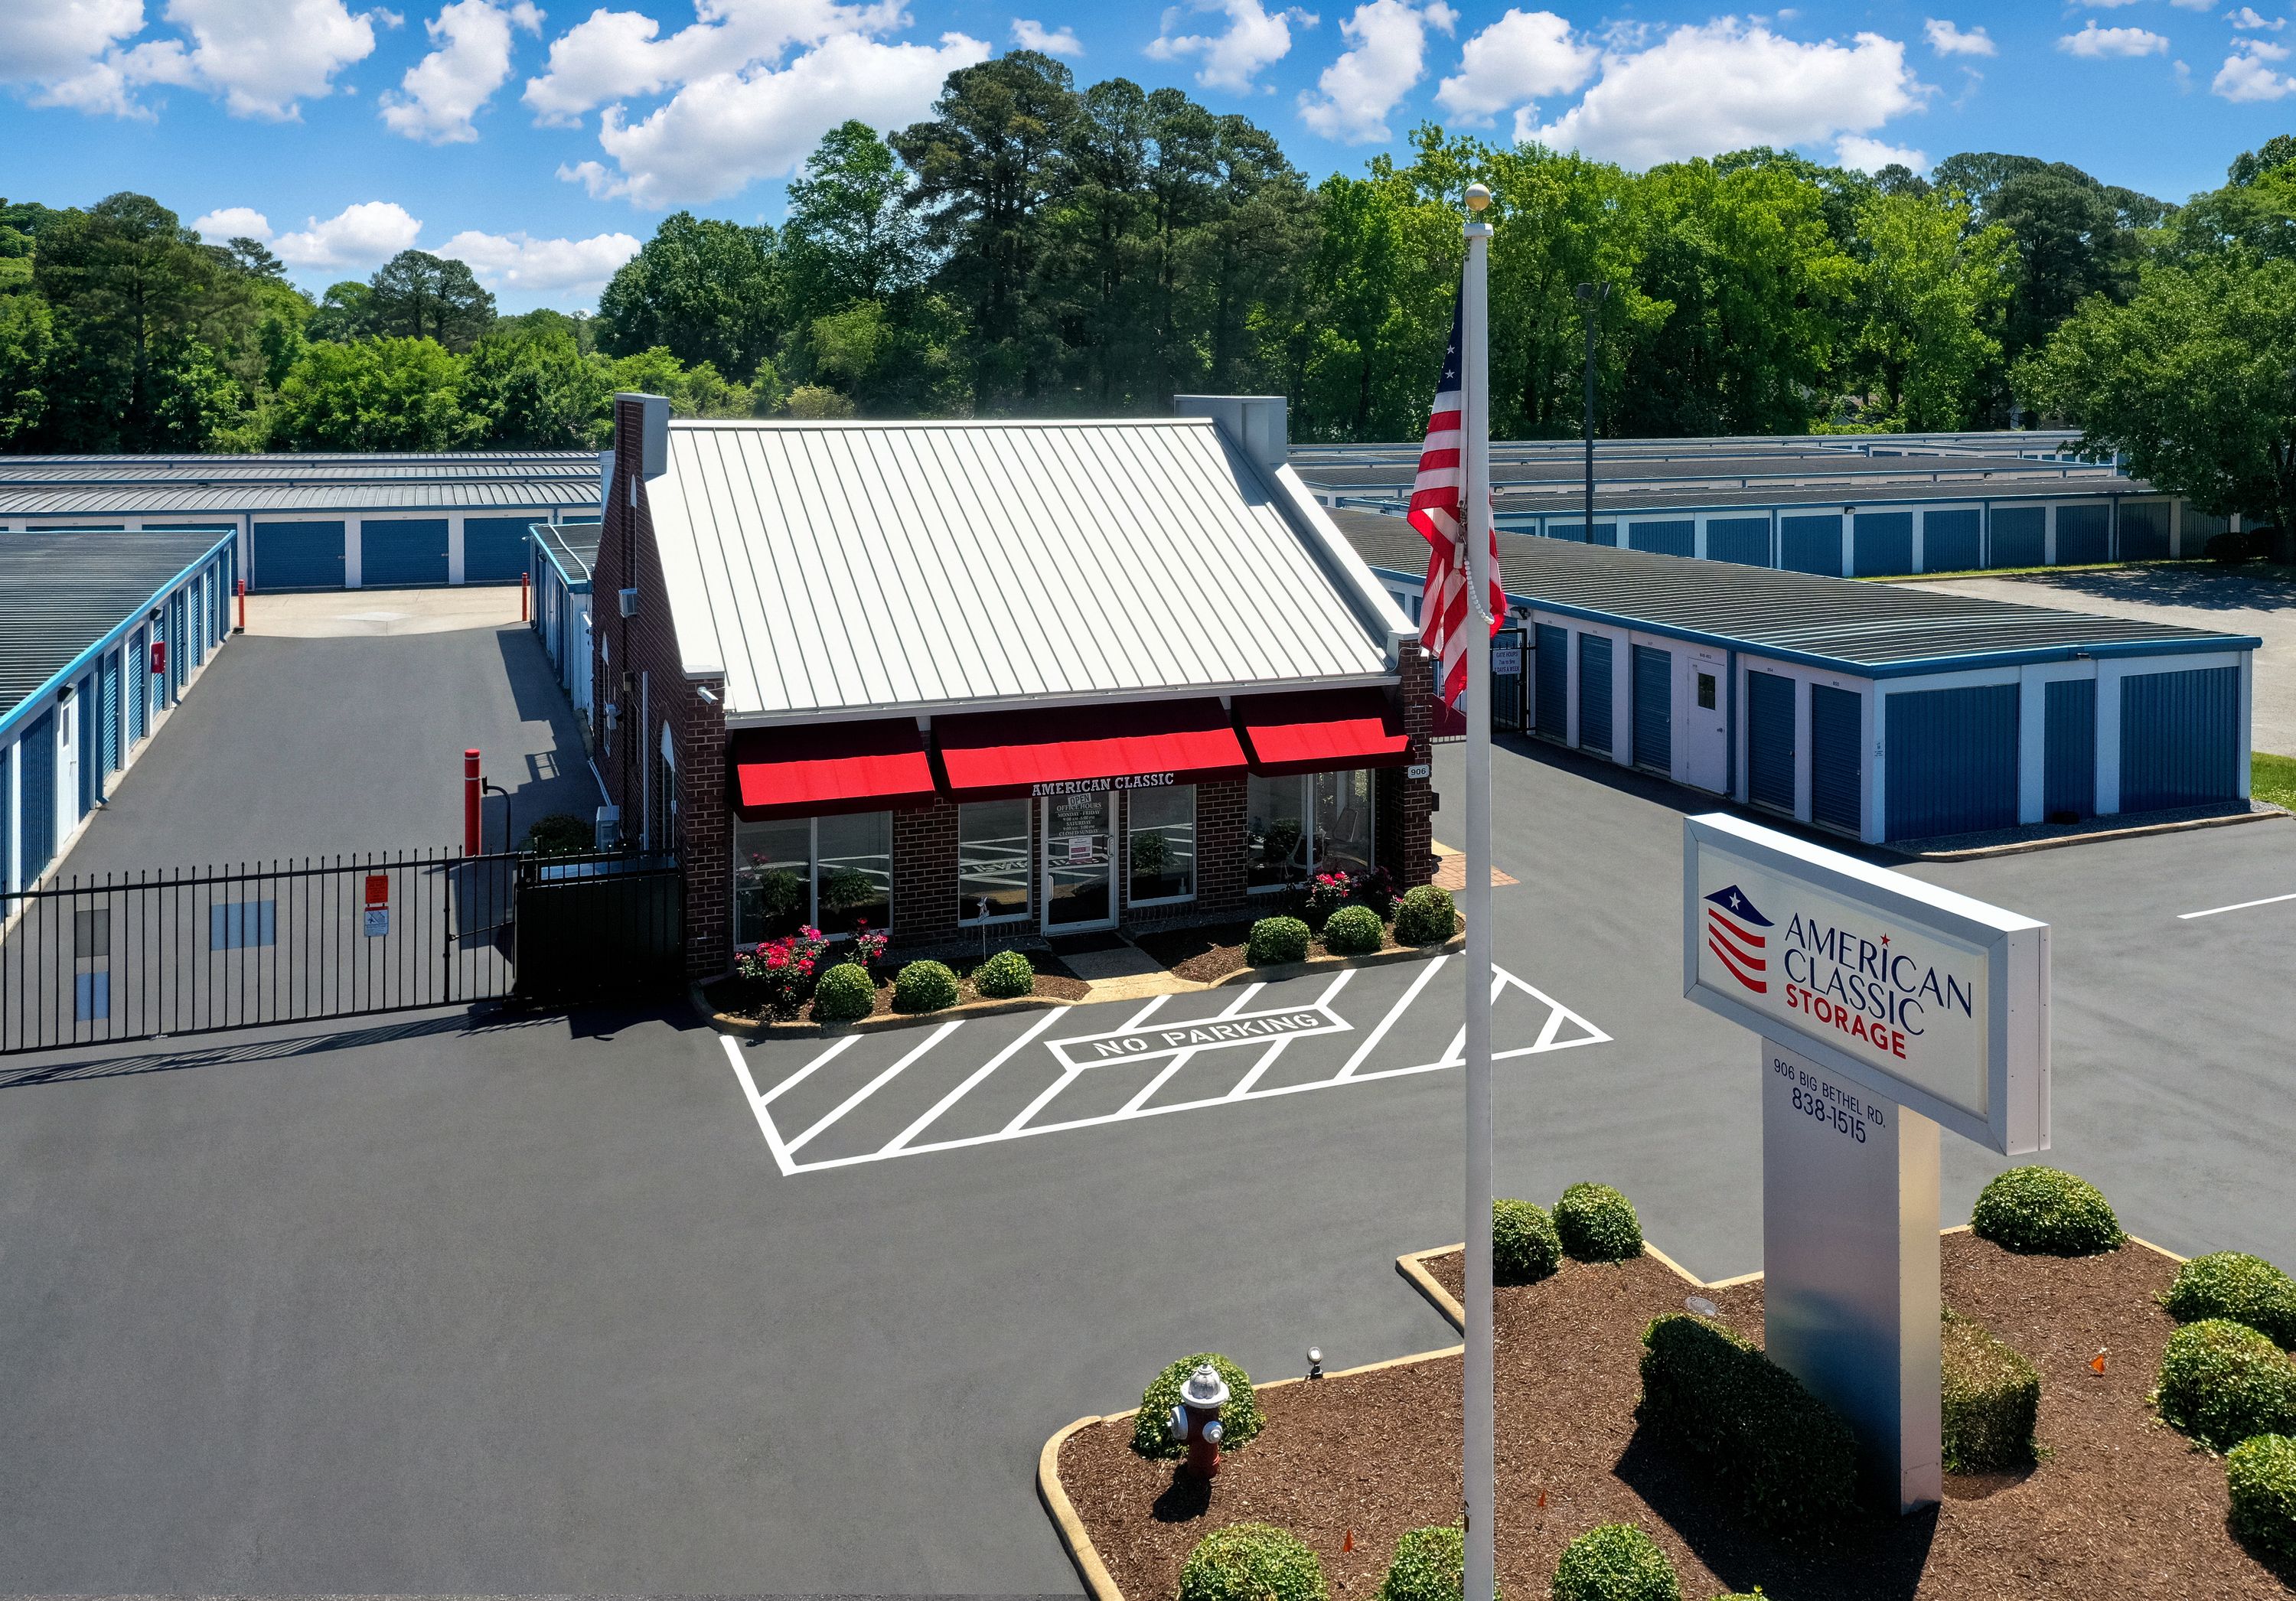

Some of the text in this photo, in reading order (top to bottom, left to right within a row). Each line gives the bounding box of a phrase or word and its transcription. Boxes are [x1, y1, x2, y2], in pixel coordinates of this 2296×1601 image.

[1032, 773, 1174, 796] AMERICAN CLASSIC
[1071, 793, 1090, 804] OPEN
[1411, 768, 1427, 776] 906
[1784, 948, 1925, 1035] CLASSIC
[1785, 912, 1972, 1019] AMERICAN
[1093, 1013, 1319, 1058] NO PARKING
[1786, 983, 1906, 1060] STORAGE
[1773, 1058, 1886, 1128] 906 BIG BETHEL RD.
[1792, 1087, 1867, 1144] 838-1515
